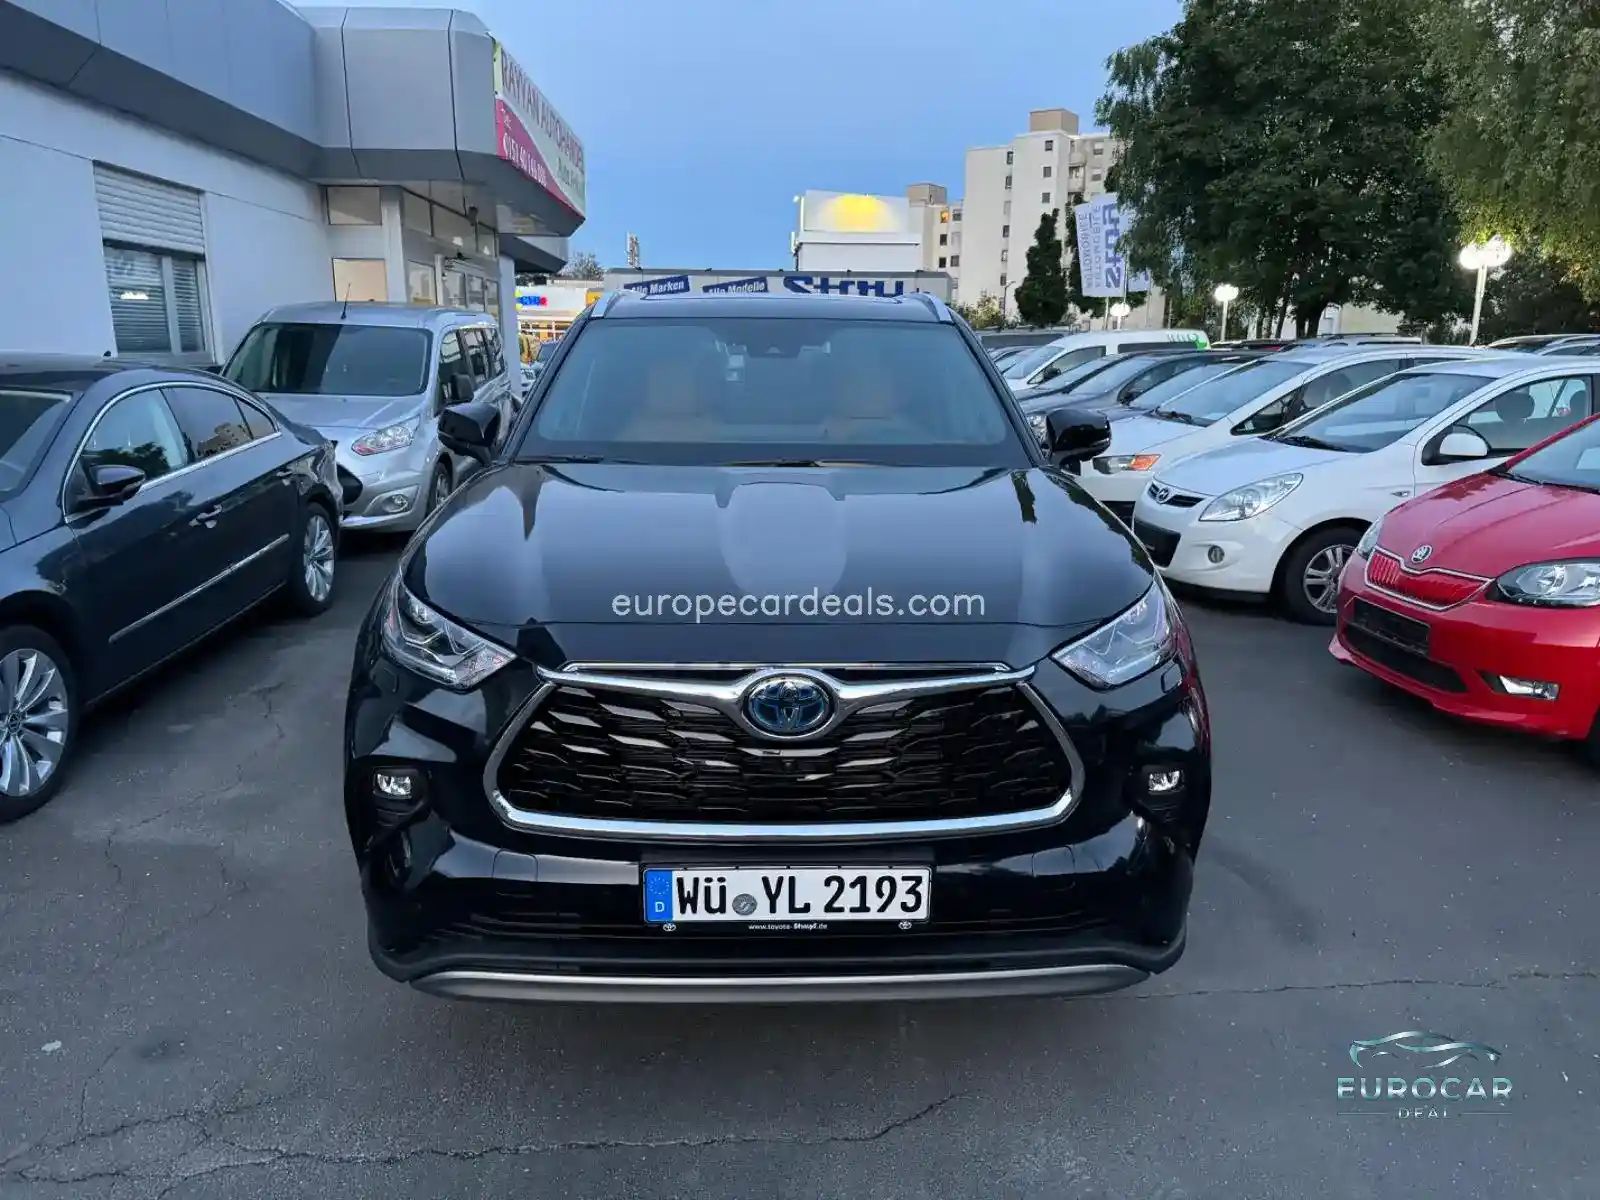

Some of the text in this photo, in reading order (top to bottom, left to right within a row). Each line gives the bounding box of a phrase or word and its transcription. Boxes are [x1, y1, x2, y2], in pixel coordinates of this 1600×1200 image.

[650, 280, 684, 294] Marken
[761, 875, 811, 914] YL
[824, 875, 923, 913] 2193
[654, 901, 665, 913] D
